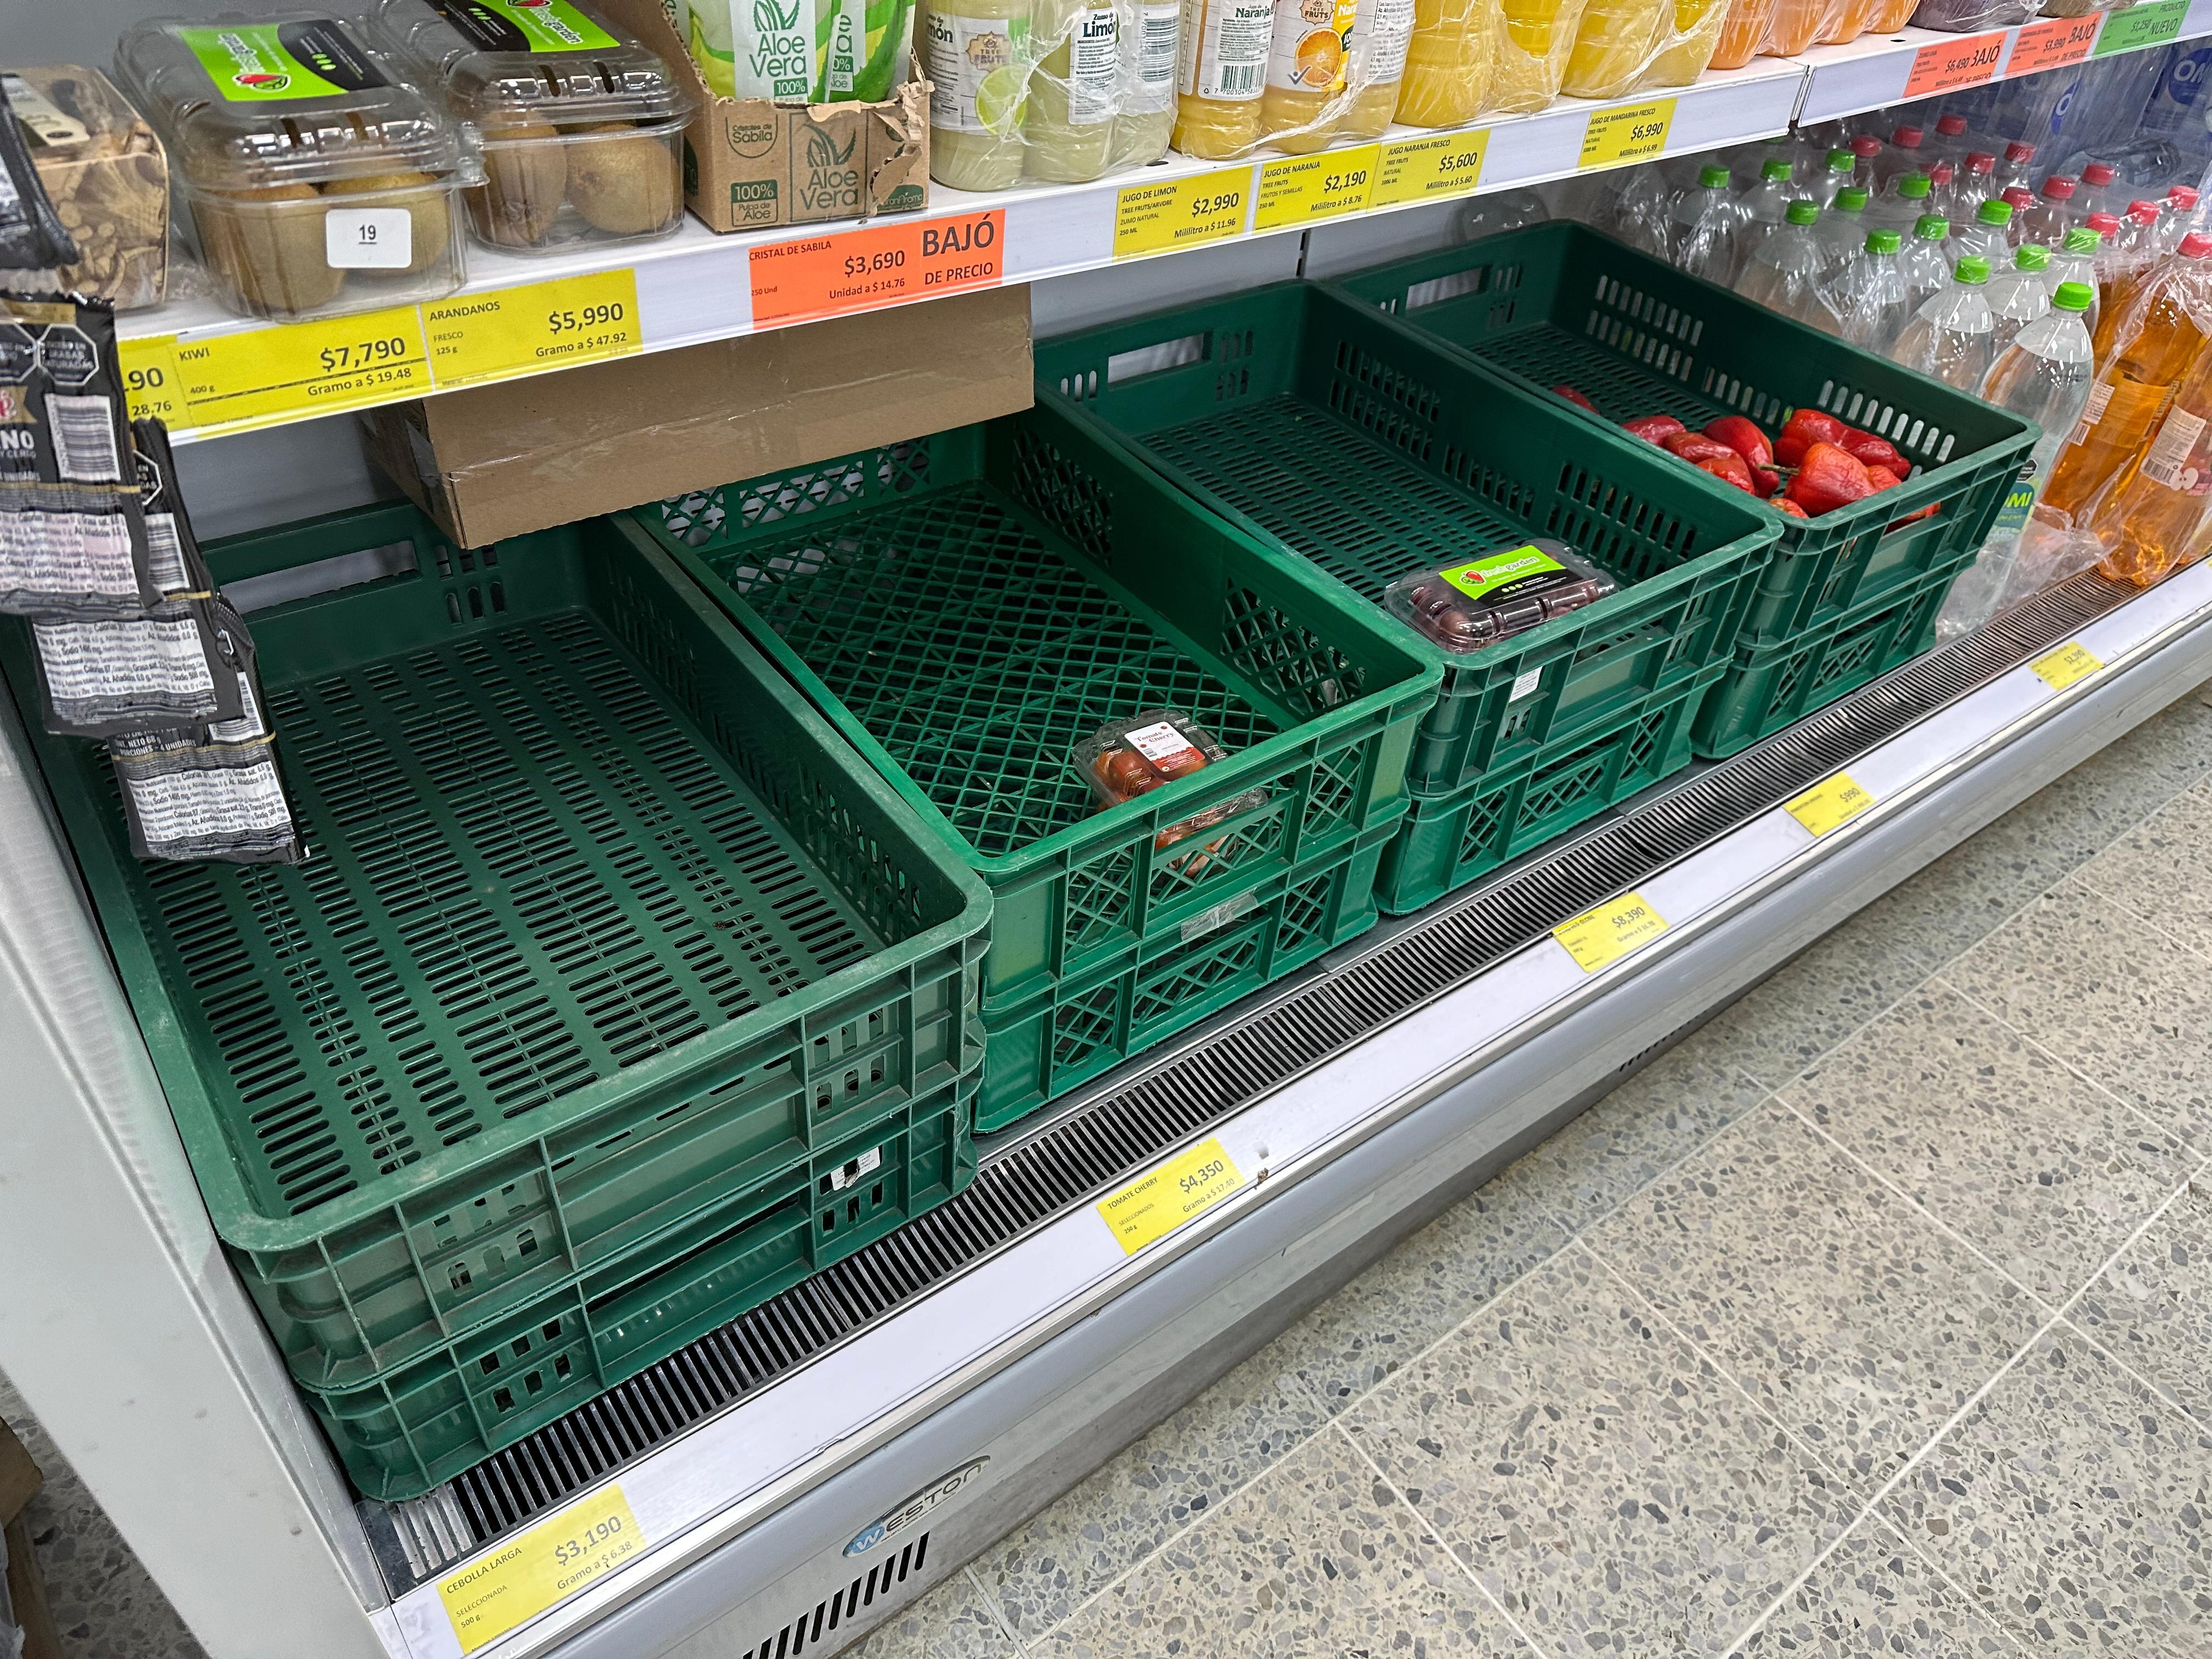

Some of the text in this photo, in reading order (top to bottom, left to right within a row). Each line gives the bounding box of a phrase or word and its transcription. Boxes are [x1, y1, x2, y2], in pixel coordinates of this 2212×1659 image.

[1235, 6, 1269, 19] Naranja
[2068, 18, 2097, 43] BAJÓ
[2151, 18, 2178, 35] NUEVO
[758, 33, 805, 57] Aloe
[749, 54, 806, 77] Vera
[777, 80, 805, 94] 100%
[1610, 111, 1638, 121] MANDARINA
[1631, 122, 1663, 142] $6,990
[1388, 139, 1451, 155] JUGO NARANJA FRESCO
[1643, 145, 1646, 154] $
[1264, 168, 1281, 178] JUGO
[1292, 161, 1320, 172] NARANJA
[1439, 152, 1477, 173] $5,600
[808, 168, 859, 190] Aloe
[1324, 171, 1367, 193] $2,190
[1455, 177, 1458, 186] $
[1460, 176, 1472, 184] 5.60
[735, 183, 774, 200] 100%
[800, 187, 859, 210] Vera
[1122, 193, 1141, 203] JUGO
[1154, 186, 1177, 196] LIMON
[1343, 197, 1347, 206] $
[1348, 195, 1362, 204] 8.76
[1192, 193, 1239, 217] $2,990
[743, 210, 770, 221] Aloe
[1137, 213, 1159, 222] NATURAL
[359, 224, 376, 240] 19
[923, 213, 994, 257] BAJÓ
[1175, 227, 1203, 238] Mililitro
[1211, 221, 1215, 231] $
[1217, 218, 1235, 229] 11.96
[749, 241, 832, 261] CRISTAL DE SABILA
[845, 250, 905, 278] $3,690
[925, 262, 992, 285] DE PRECIO
[830, 285, 862, 298] Unidad
[873, 282, 878, 292] $
[881, 278, 905, 290] 14.76
[430, 301, 500, 321] ARANDANOS
[549, 303, 623, 335] $5,990
[433, 331, 464, 342] FRESCO
[536, 332, 627, 357] Gramo a $ 47.92
[179, 347, 210, 361] KIWI
[320, 337, 405, 372] $7,790
[436, 346, 457, 355] 125 g
[190, 385, 207, 394] 400
[308, 368, 411, 396] Gramo a $ 19.48
[132, 401, 172, 416] 28.76
[1134, 731, 1163, 742] Tomate
[1149, 732, 1174, 742] Cherry
[1612, 907, 1645, 928] $8,390
[1180, 1159, 1224, 1194] $4,350
[1107, 1176, 1158, 1210] TOMATE CHERRY
[1183, 1197, 1205, 1212] Gramo
[1216, 1178, 1234, 1193] 17.40
[1119, 1203, 1154, 1226] SELECCIONADOS
[1124, 1226, 1133, 1234] 250
[555, 1515, 622, 1566] $3,190
[447, 1547, 522, 1595] CEBOLLA LARGA
[557, 1541, 633, 1590] Gramo a $ 6.38
[456, 1584, 507, 1617] SELECCIONADA
[461, 1613, 481, 1628] 500 g
